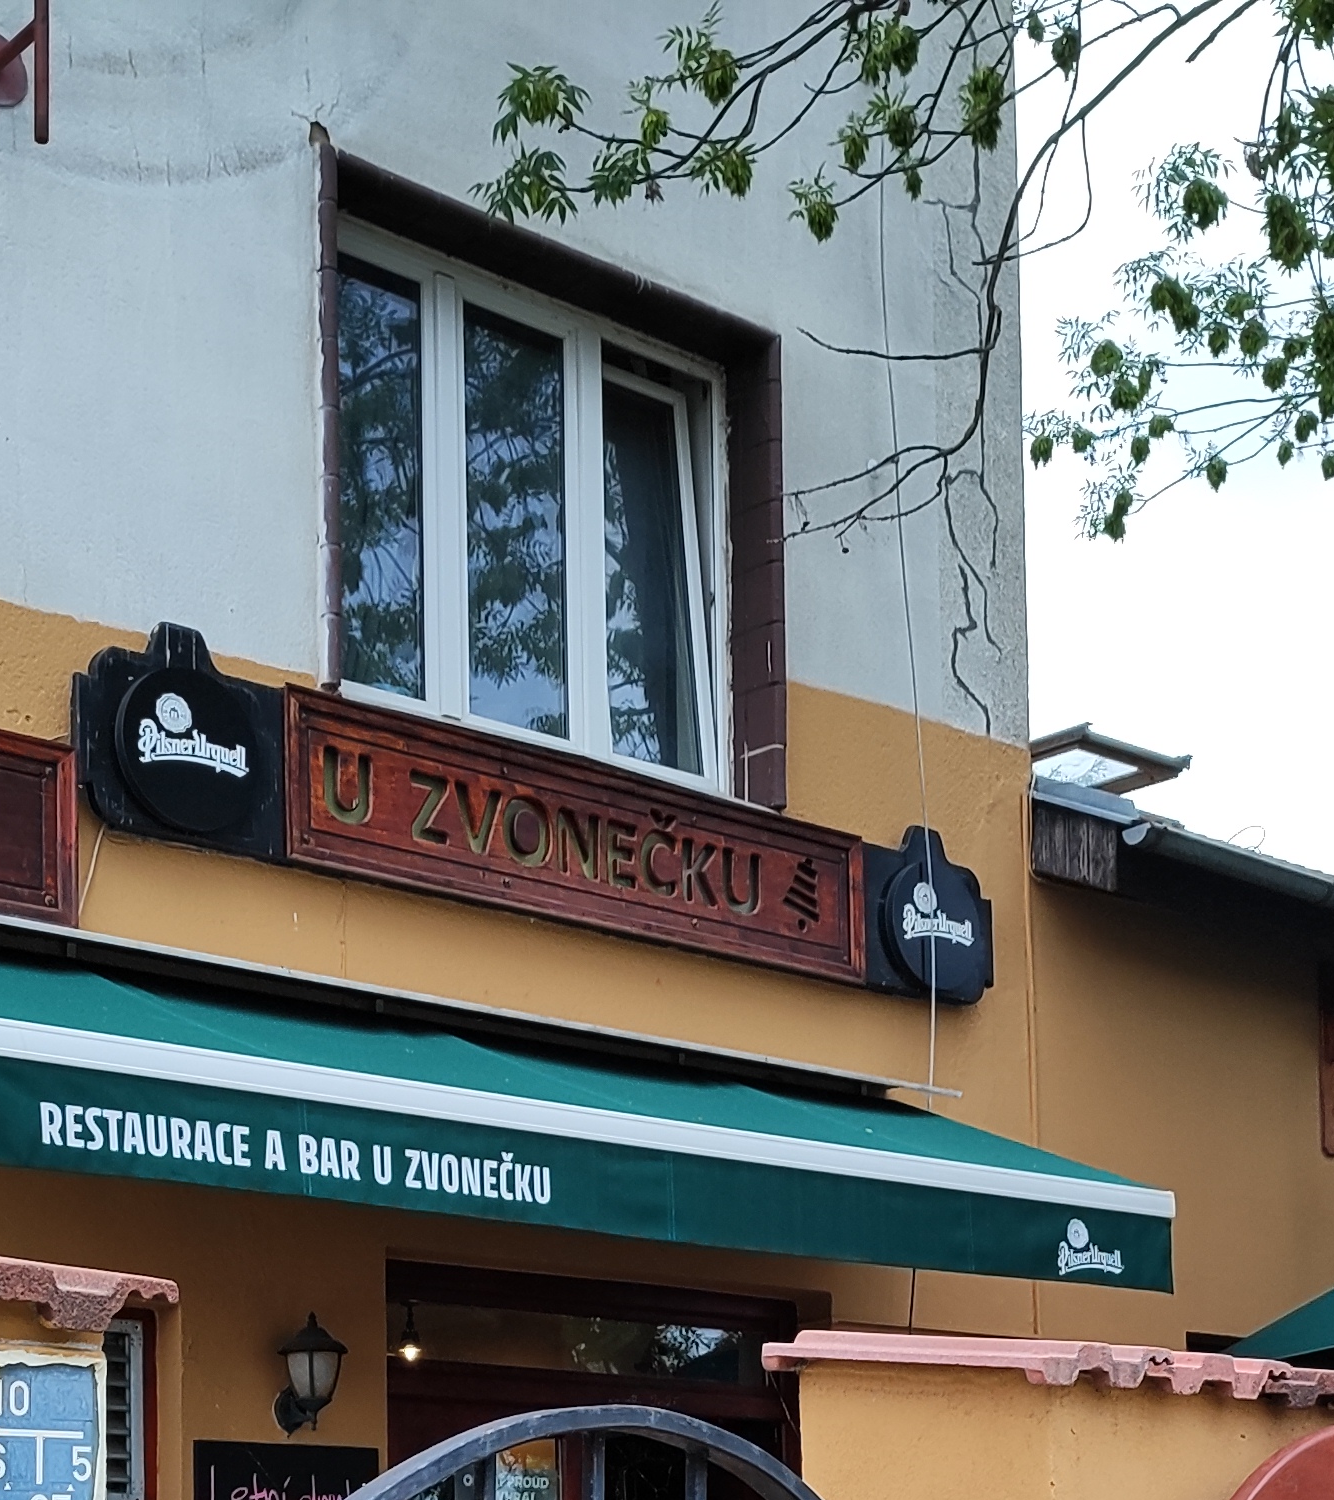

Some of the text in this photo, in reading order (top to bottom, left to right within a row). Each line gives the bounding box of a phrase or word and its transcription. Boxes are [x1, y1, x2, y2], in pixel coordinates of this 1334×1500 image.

[323, 745, 762, 916] U ZVONEČKU
[39, 1102, 552, 1204] RESTAURACE A BAR U ZVONEČKU
[73, 1446, 92, 1482] 5
